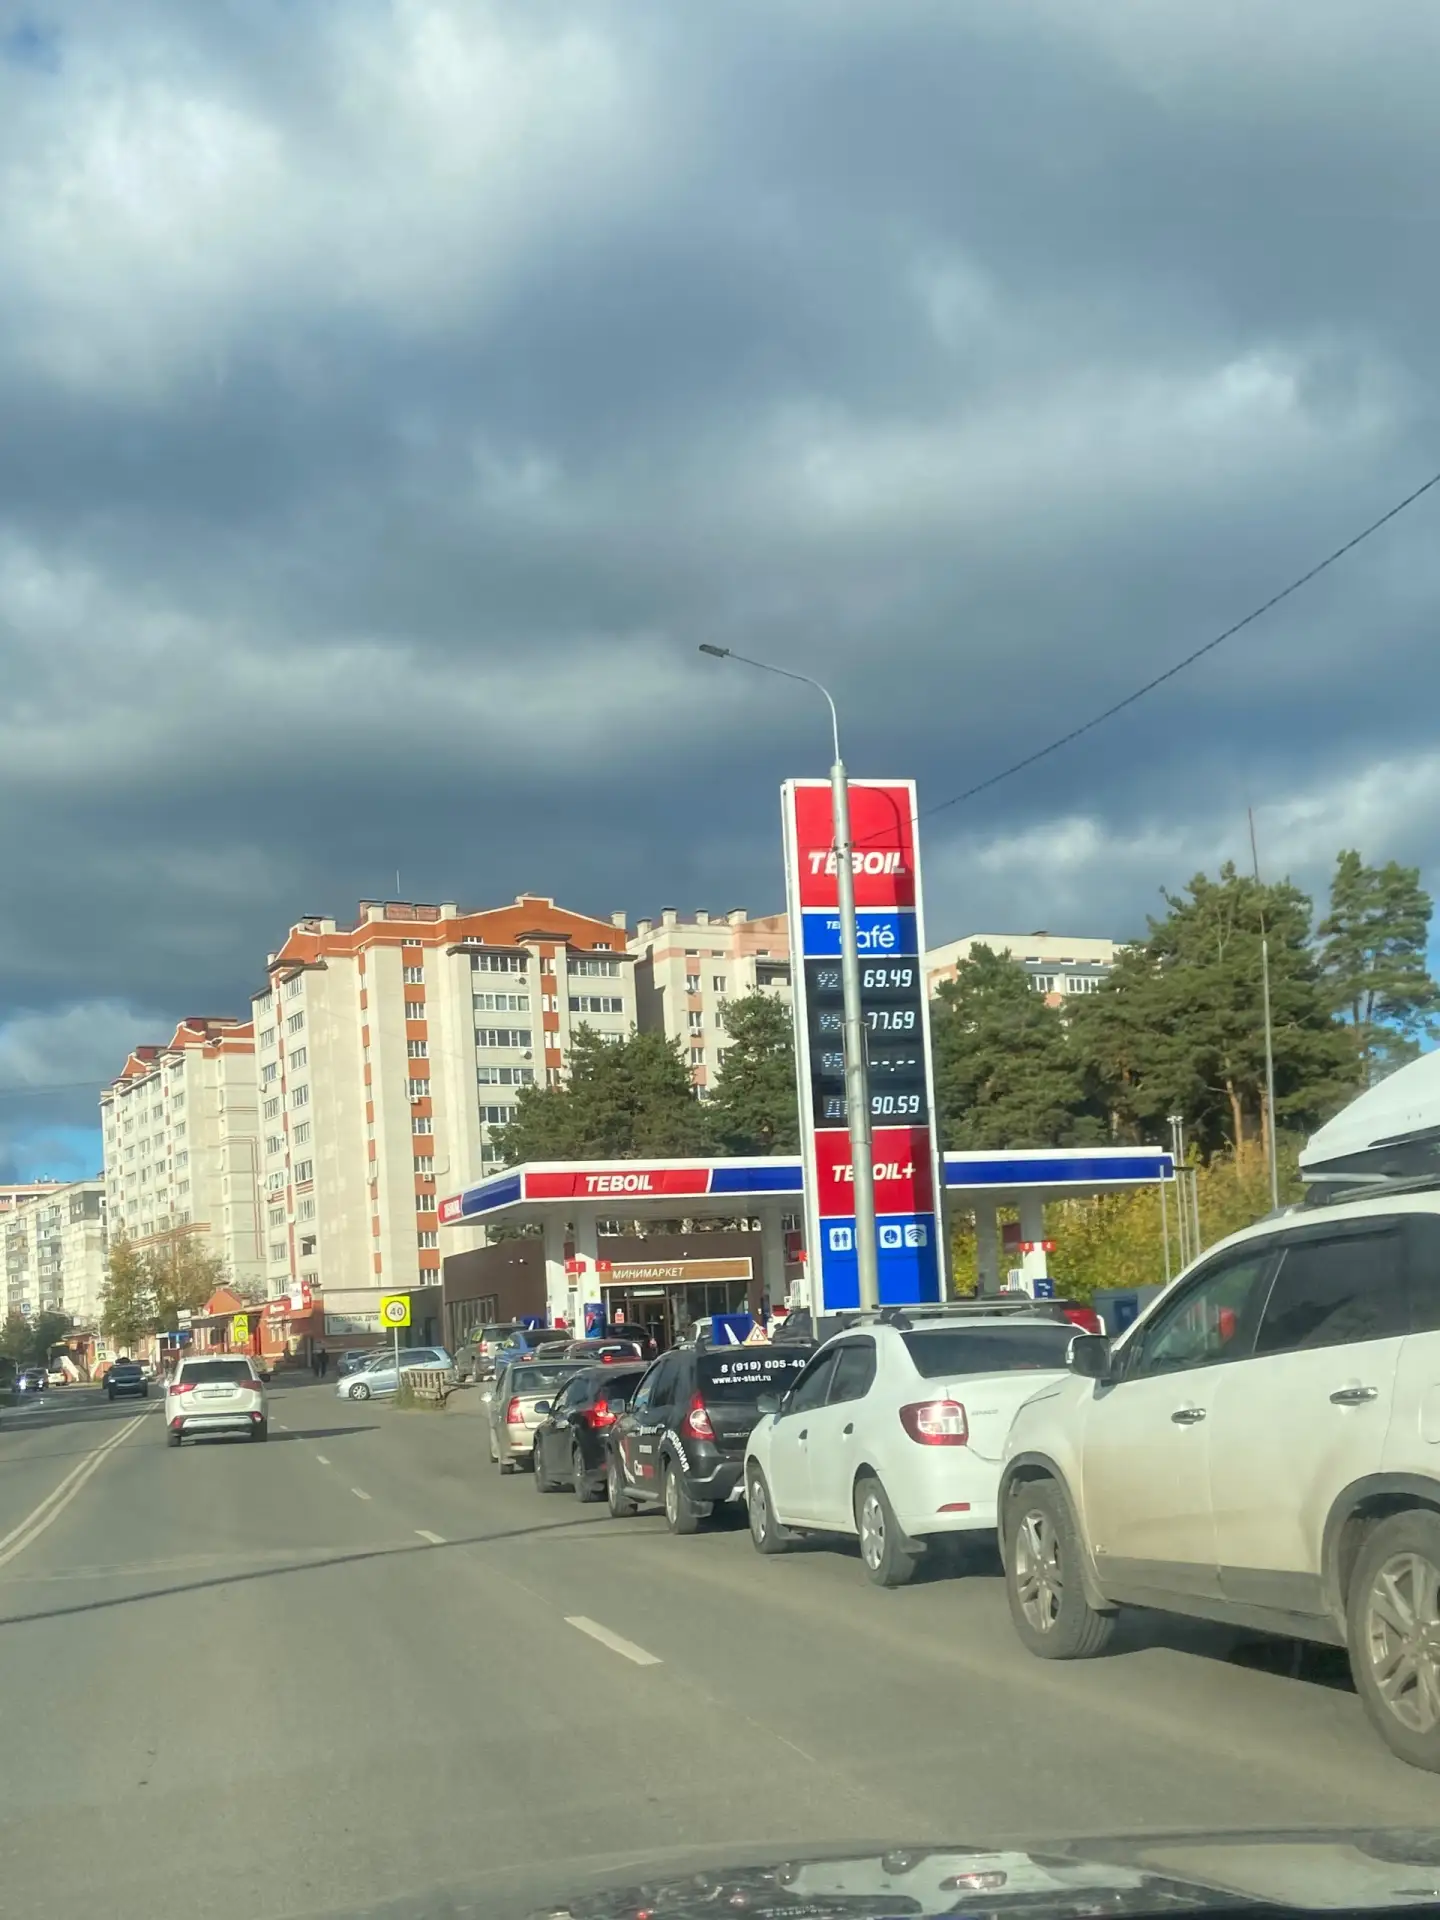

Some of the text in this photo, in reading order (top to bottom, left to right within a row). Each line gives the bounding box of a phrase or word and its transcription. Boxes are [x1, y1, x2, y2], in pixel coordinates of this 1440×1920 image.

[839, 924, 895, 948] afé
[817, 969, 912, 989] 92 69.49
[820, 1011, 915, 1030] 95 77.69
[871, 1095, 920, 1114] 90.59
[832, 1162, 916, 1182] TEOIL+
[585, 1174, 653, 1192] TEBOIL
[600, 1262, 606, 1270] 2
[612, 1267, 684, 1279] МИНИМАРКЕТ
[390, 1307, 404, 1316] 40
[721, 1359, 806, 1373] 8 (919) 005-40
[712, 1374, 772, 1385] www.av-start.ru
